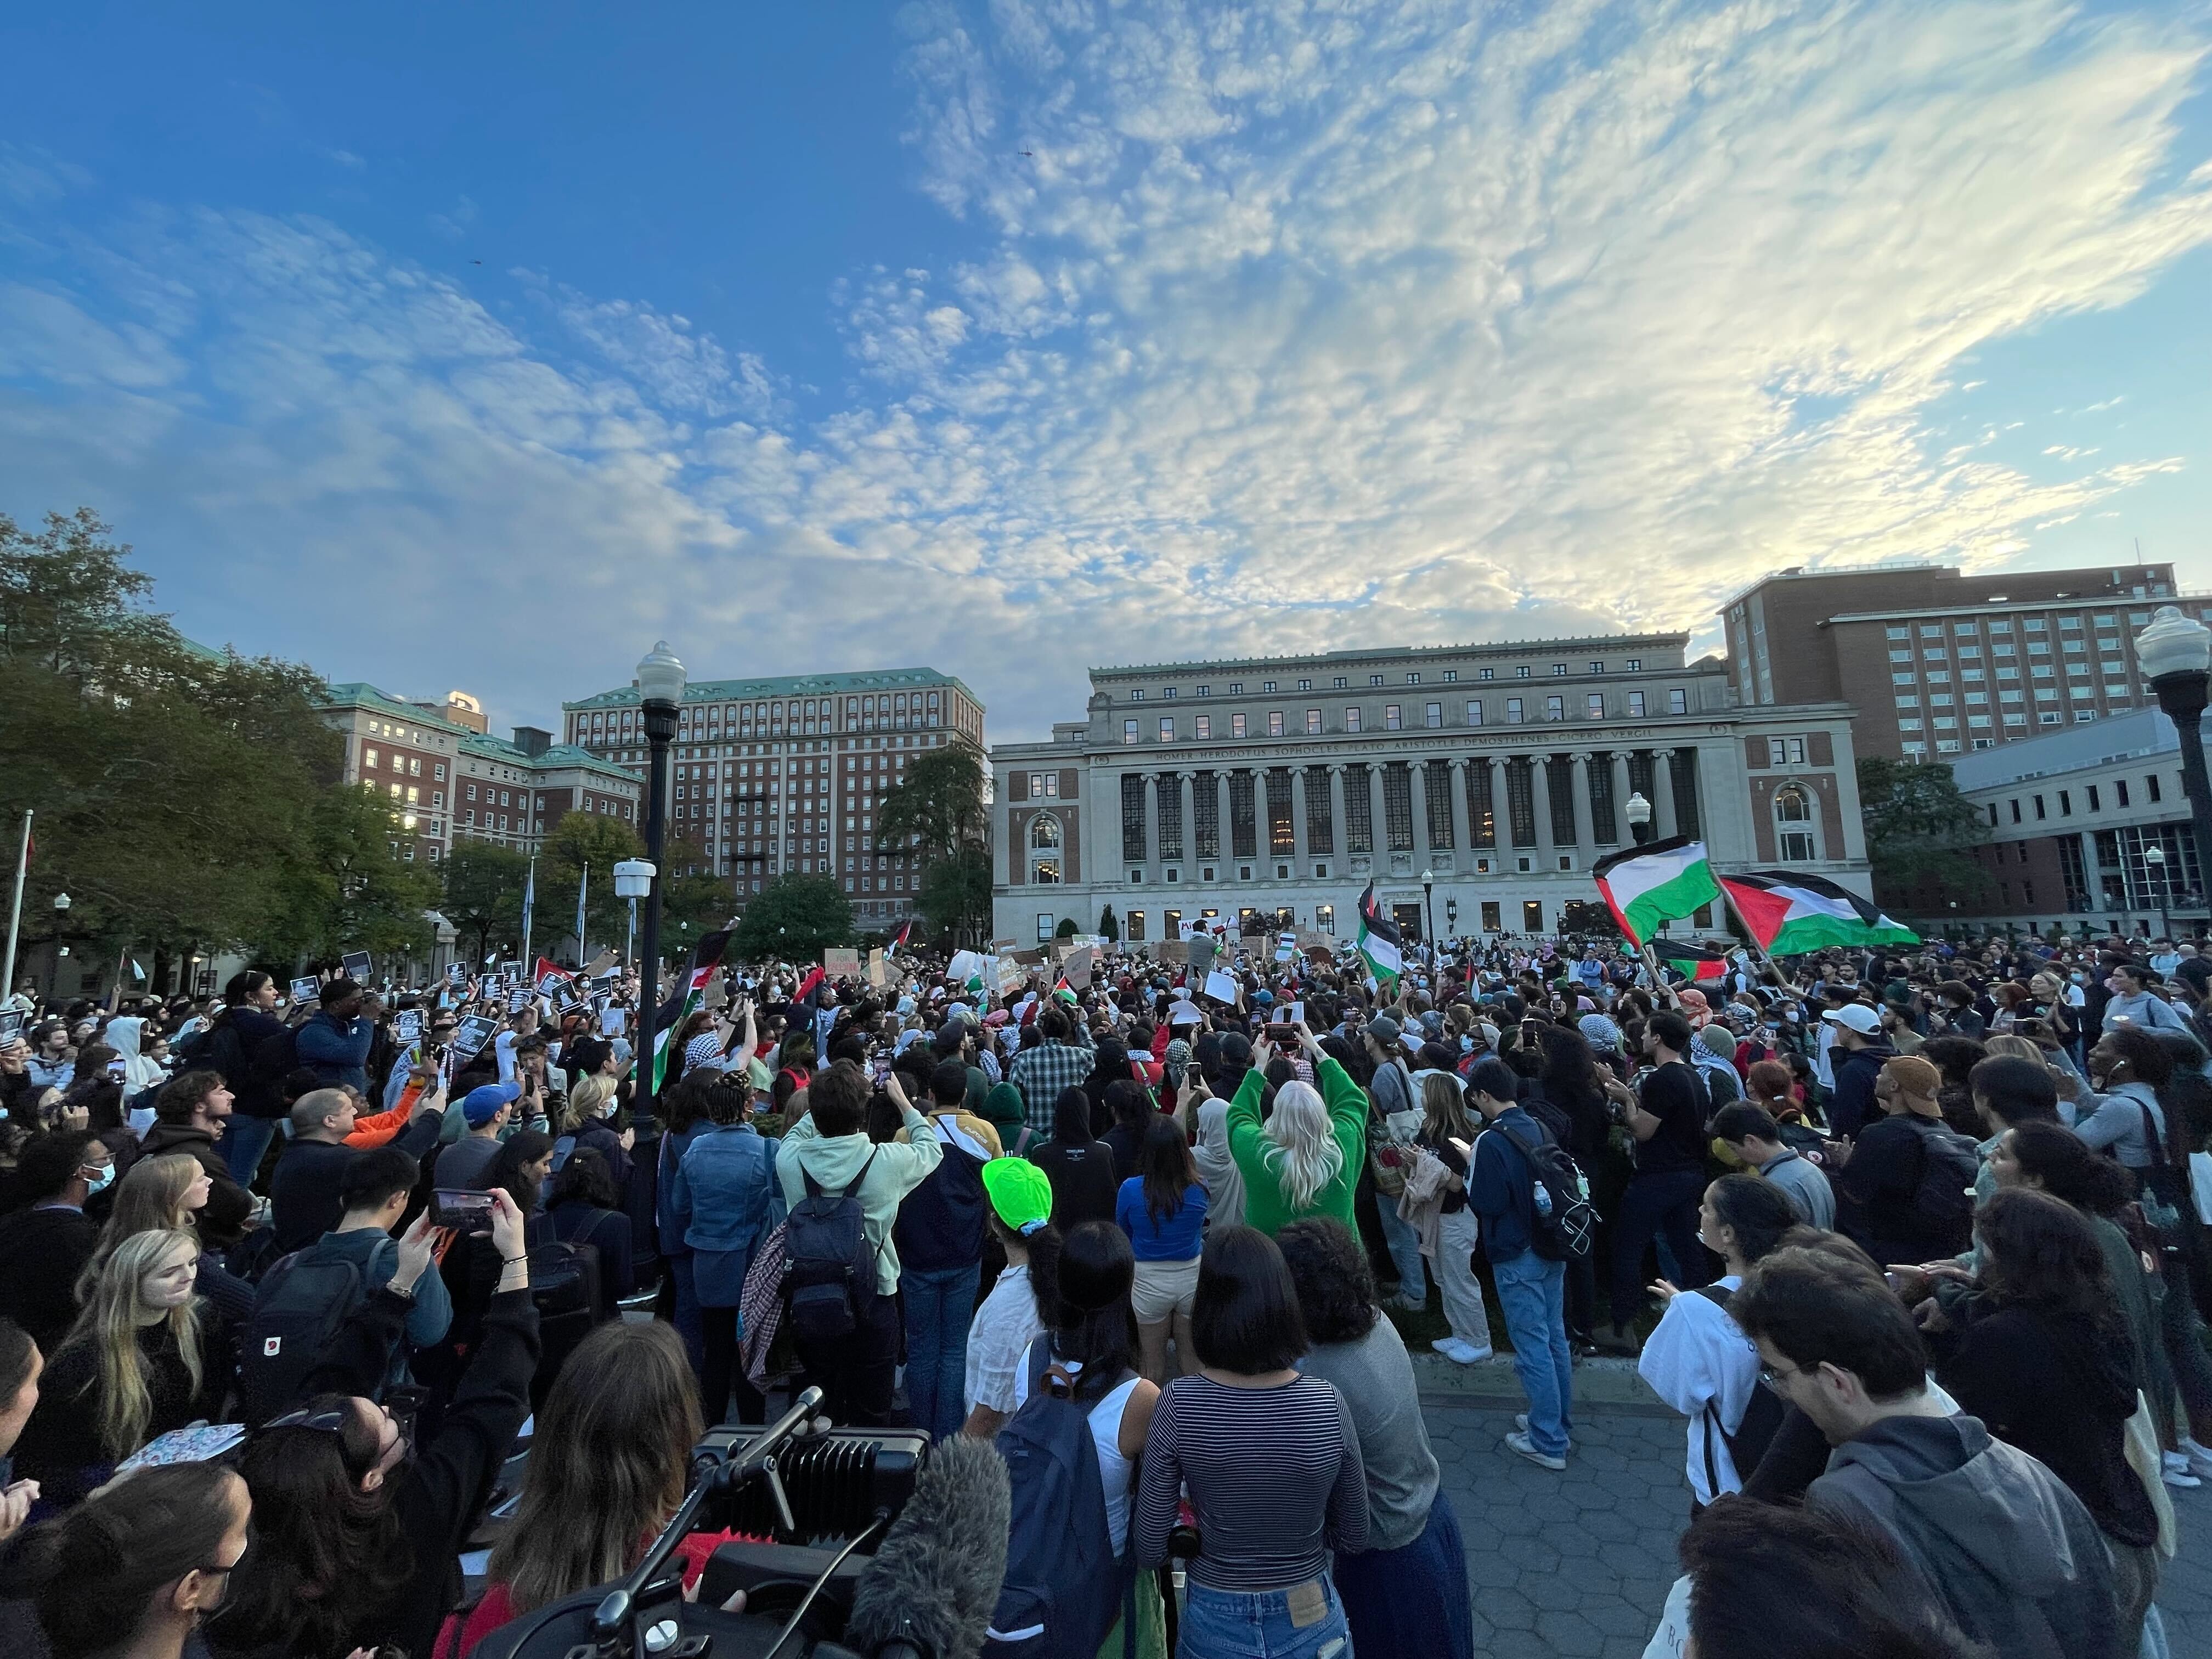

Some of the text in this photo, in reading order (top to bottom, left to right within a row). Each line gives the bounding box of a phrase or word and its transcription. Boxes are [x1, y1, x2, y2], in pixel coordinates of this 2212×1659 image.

[1156, 729, 1654, 761] HOMER HERODOTUS SOPHOCLES PLATO ARISTOTLE DEMOSTHENES CICERO VERGIL
